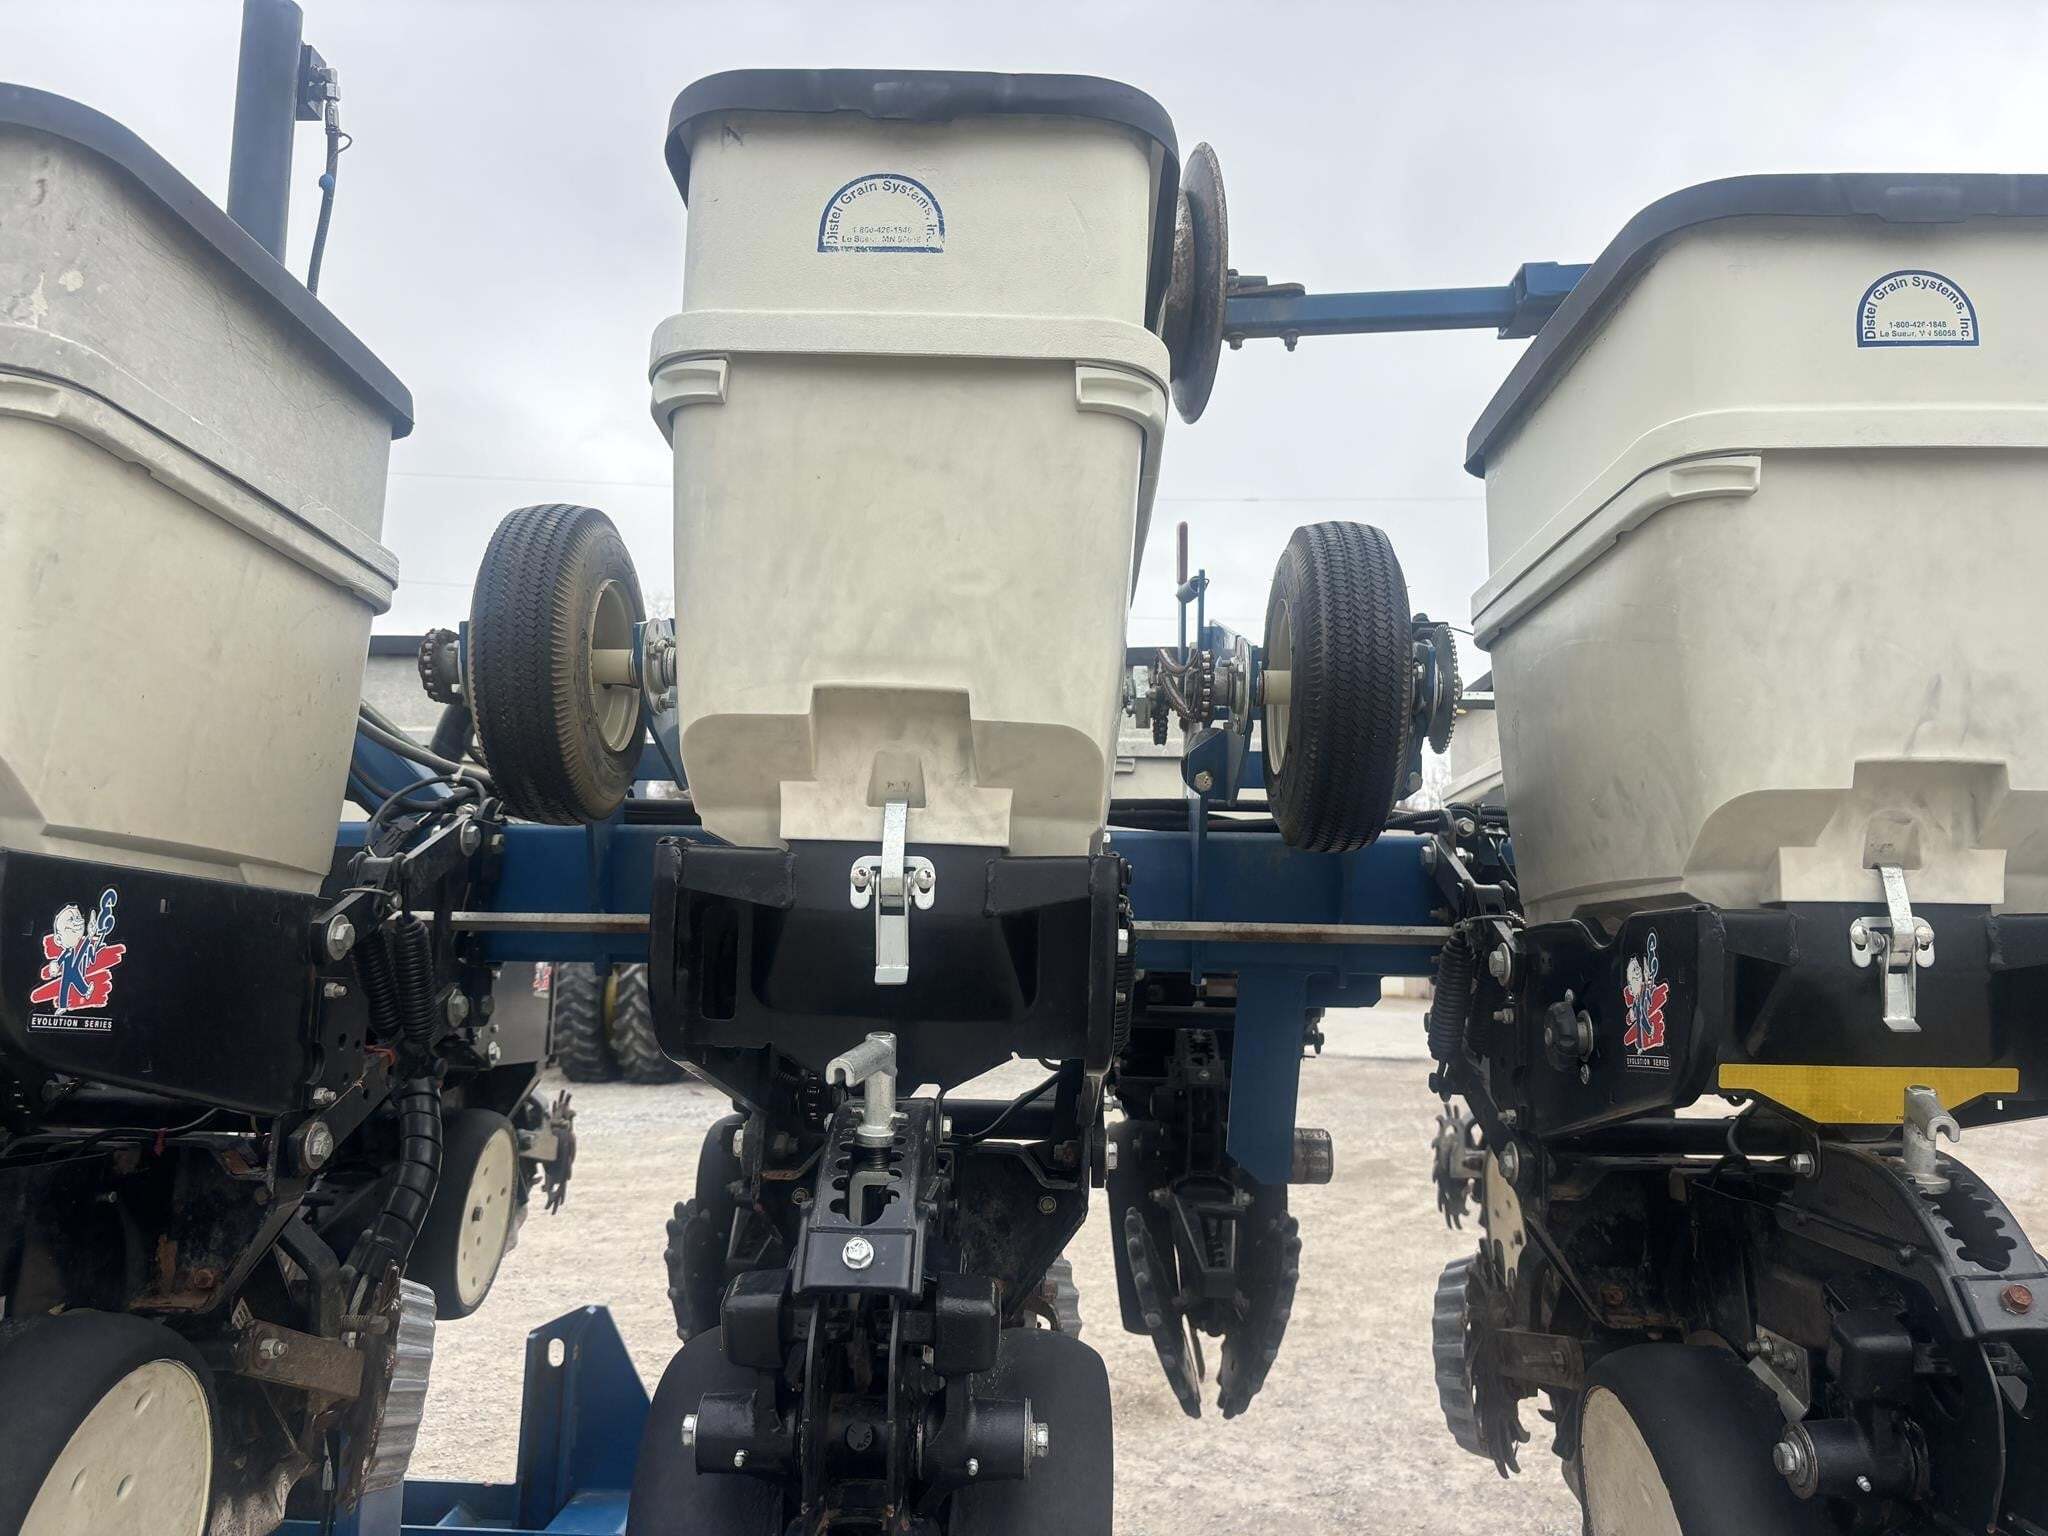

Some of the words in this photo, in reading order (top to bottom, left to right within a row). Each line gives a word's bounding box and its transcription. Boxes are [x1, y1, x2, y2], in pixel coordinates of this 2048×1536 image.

[826, 206, 843, 244] Distel
[841, 181, 877, 205] Grain
[1864, 301, 1878, 340] Distel
[1873, 278, 1908, 301] Grain
[1912, 276, 1965, 315] Systems,
[1960, 318, 1971, 341] Inc.
[1879, 330, 1890, 338] Le
[31, 1017, 78, 1027] EVOLUTION
[84, 1020, 113, 1029] SERIES
